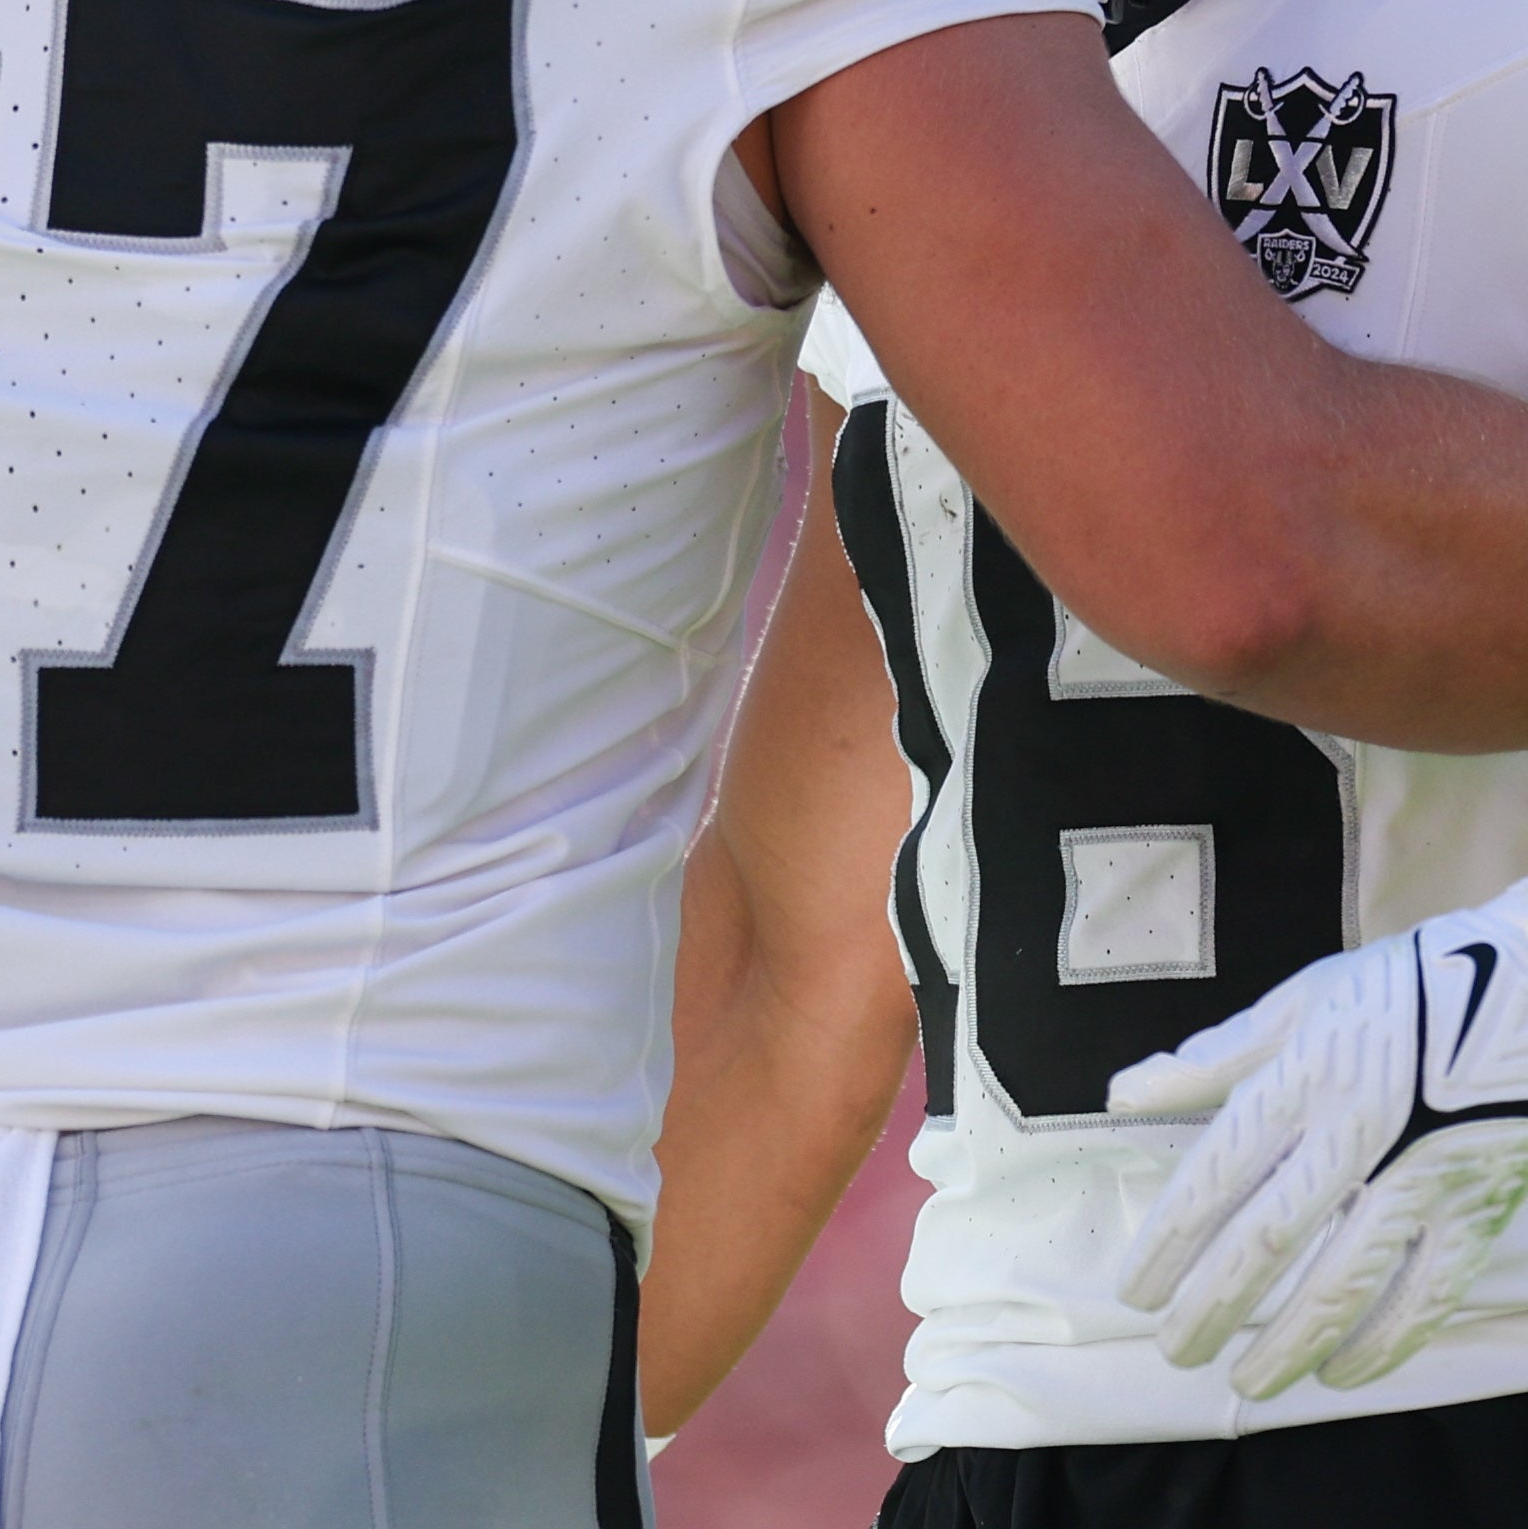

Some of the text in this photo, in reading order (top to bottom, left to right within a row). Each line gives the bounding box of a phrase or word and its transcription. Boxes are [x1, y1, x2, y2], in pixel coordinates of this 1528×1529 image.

[1226, 139, 1374, 211] LXV
[1262, 237, 1310, 252] RAIDERS
[1312, 264, 1349, 283] 2024
